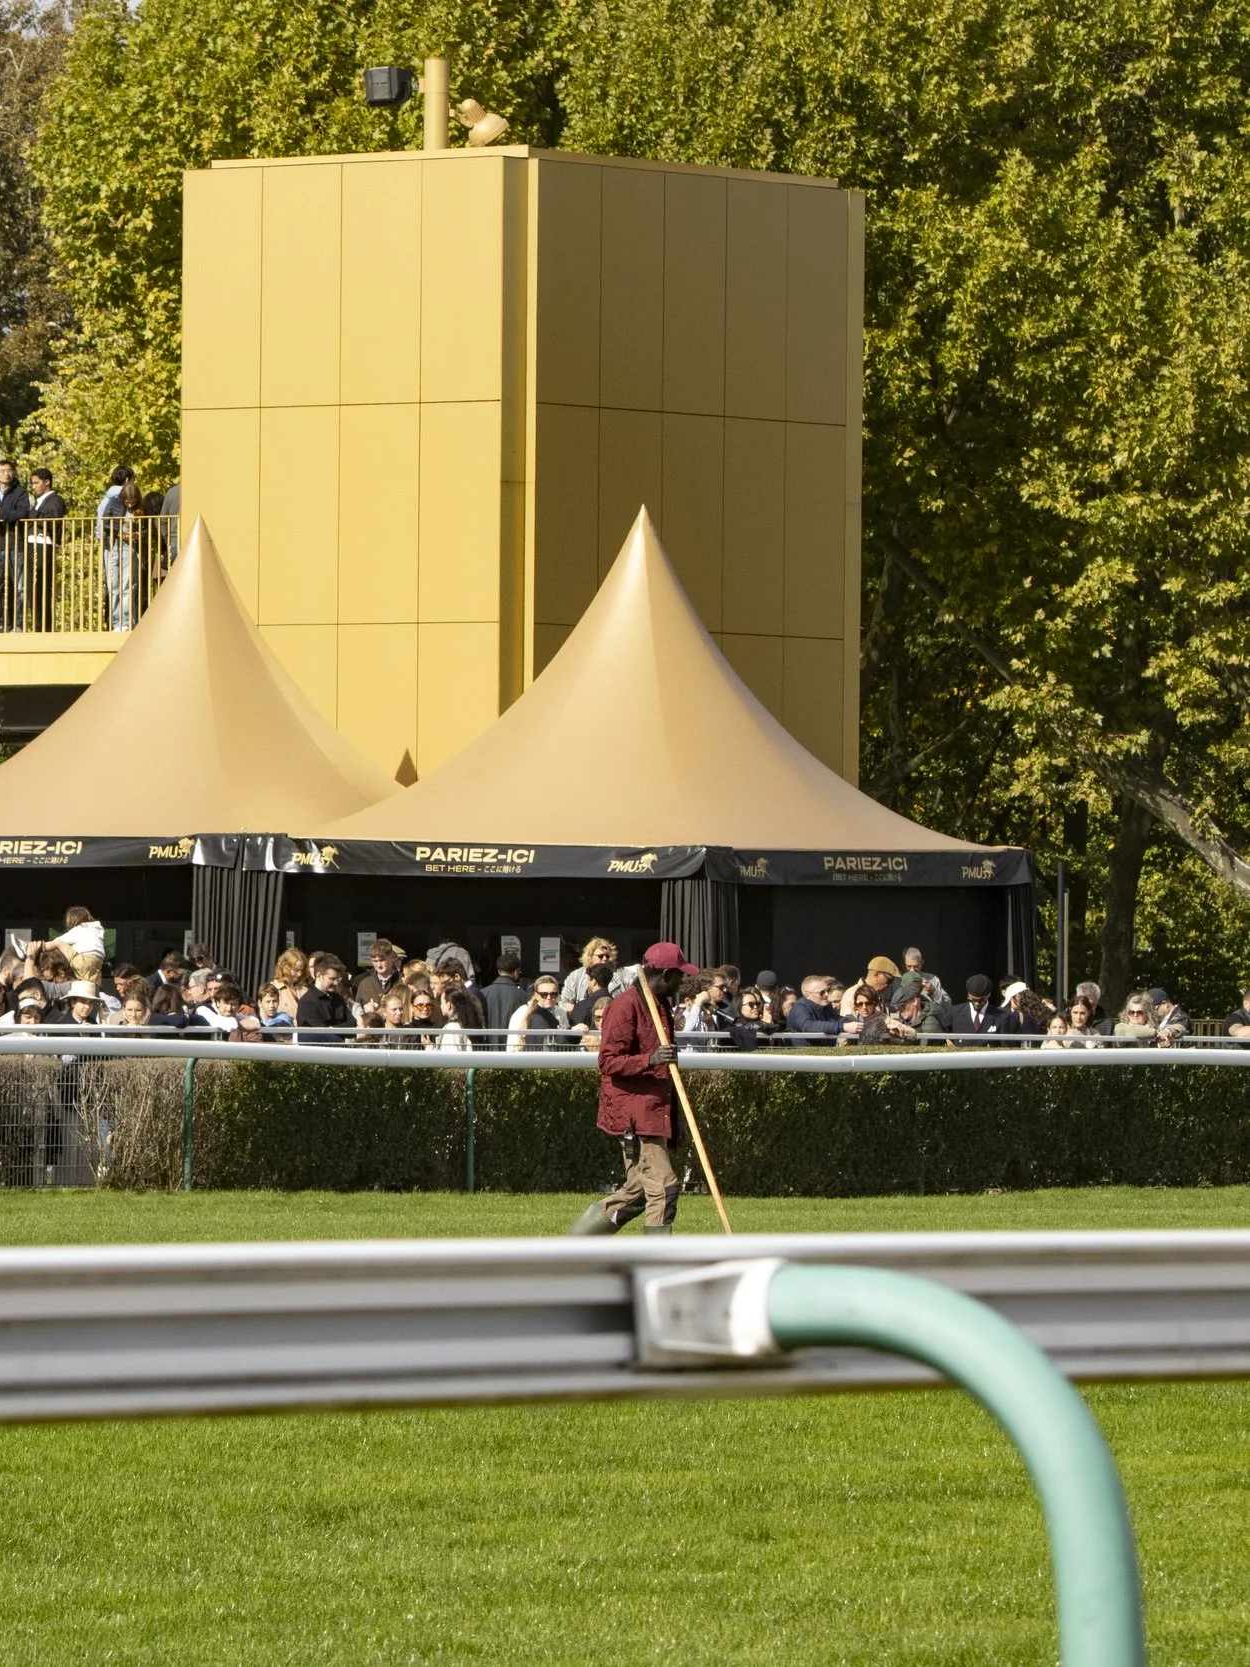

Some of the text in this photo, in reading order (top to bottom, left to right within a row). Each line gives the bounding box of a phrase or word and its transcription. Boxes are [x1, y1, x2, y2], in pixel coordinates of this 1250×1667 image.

[148, 846, 179, 859] PMU
[415, 846, 535, 863] PARIEZ-ICI
[425, 864, 446, 872] BET
[447, 865, 476, 873] HERE
[607, 860, 639, 873] PMU
[823, 856, 908, 871] PARIEZ-ICI
[961, 866, 983, 879] PMU
